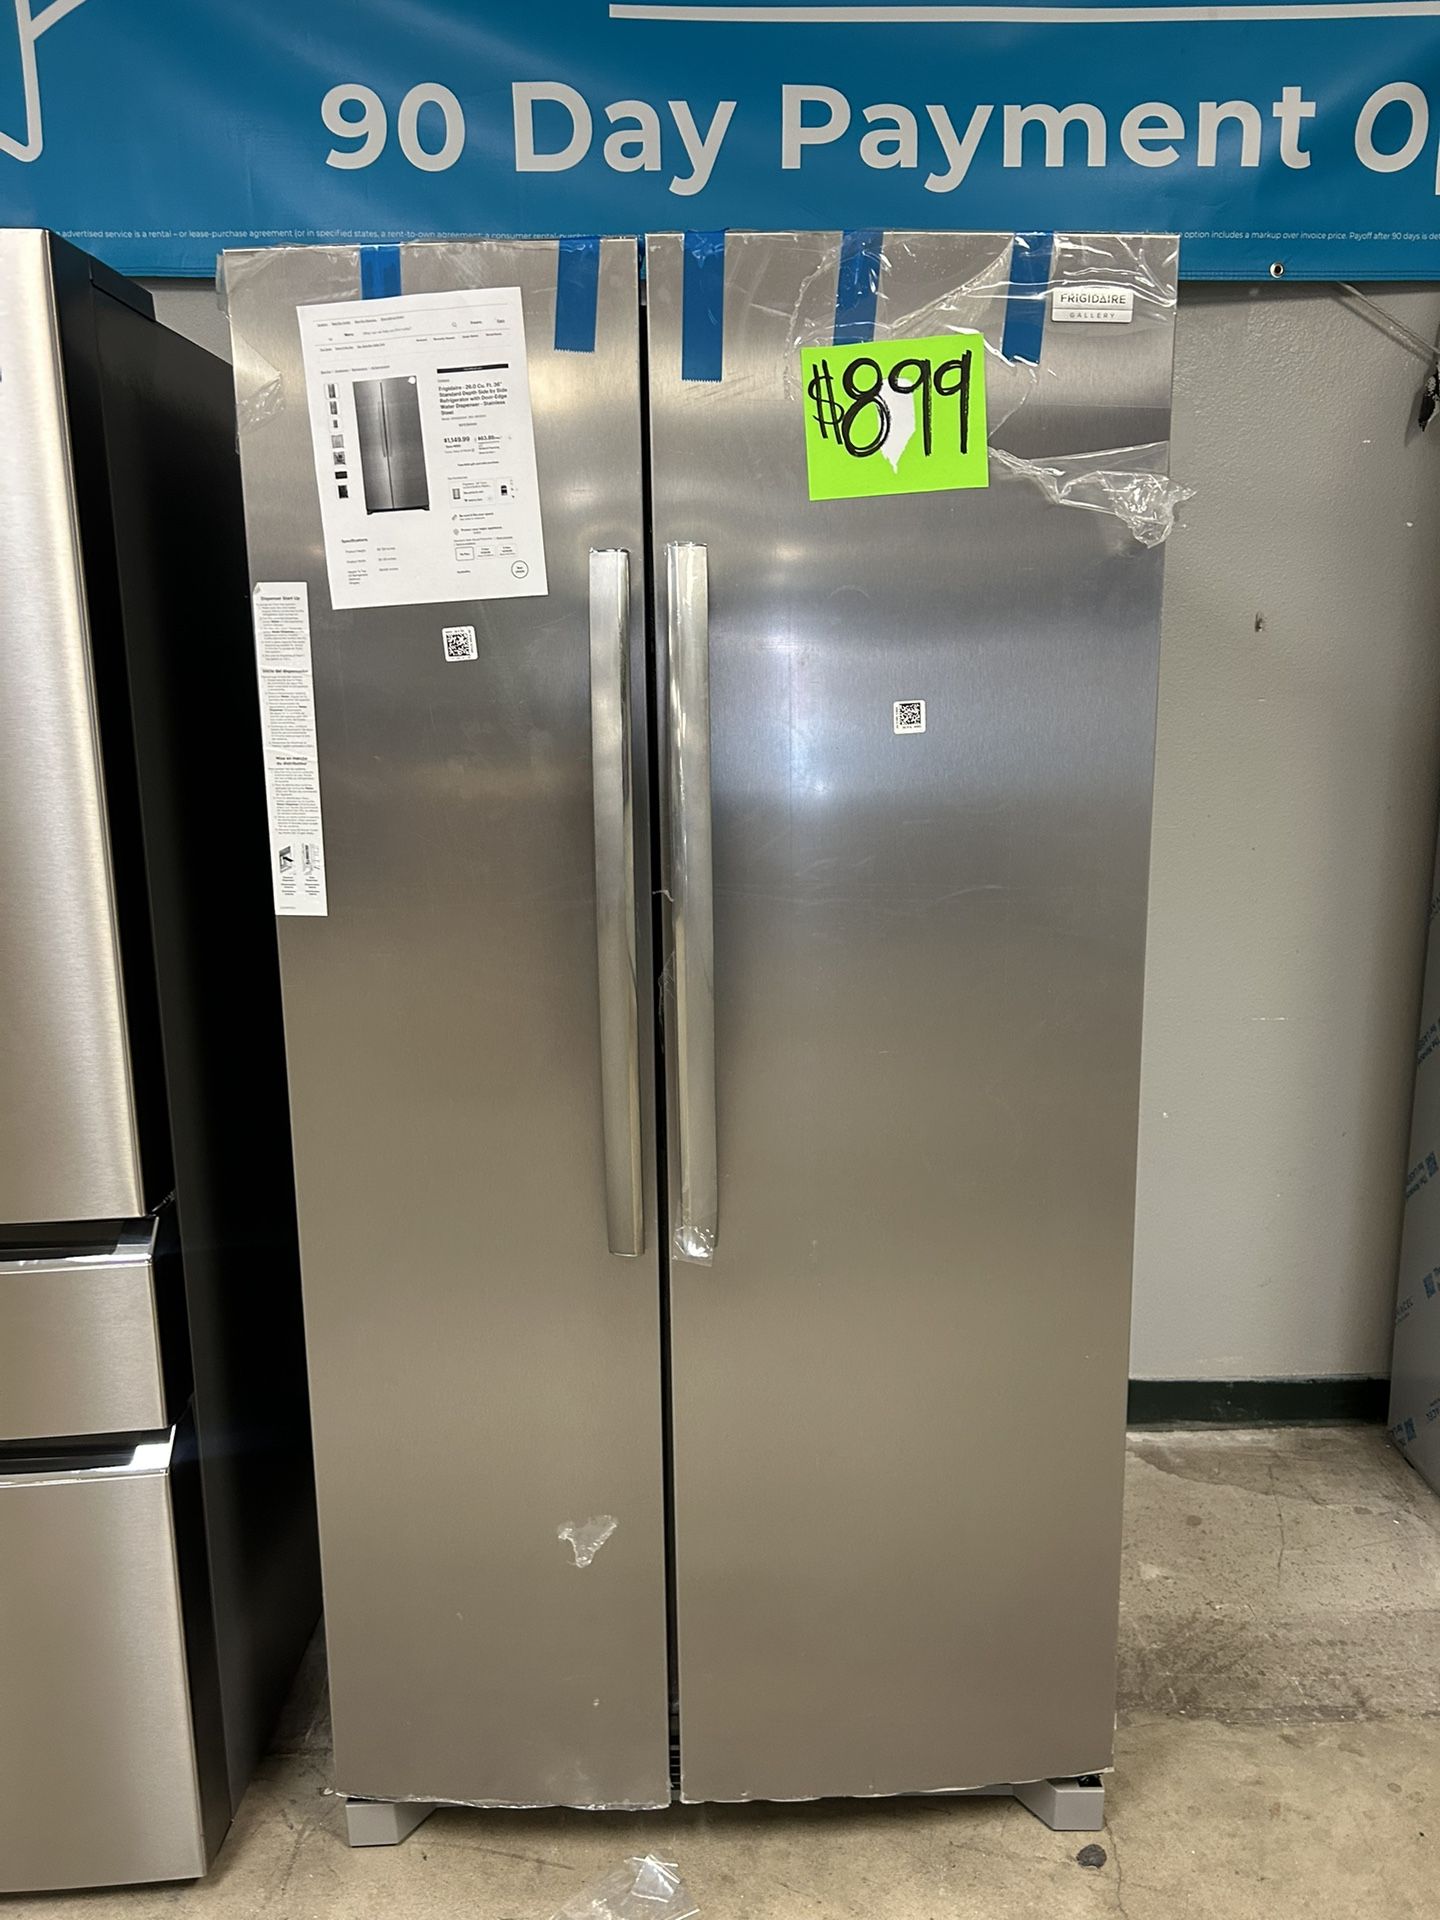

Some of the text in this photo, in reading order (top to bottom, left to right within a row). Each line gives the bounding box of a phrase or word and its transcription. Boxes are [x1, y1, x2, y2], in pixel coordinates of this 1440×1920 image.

[320, 81, 1440, 196] 90 Day Payment O
[63, 231, 103, 239] advertised
[105, 231, 133, 239] service
[134, 231, 140, 239] is
[149, 231, 171, 239] rental
[189, 231, 247, 240] lease-purchase
[249, 231, 293, 241] agreement
[307, 230, 315, 238] in
[316, 230, 353, 240] specified
[354, 231, 380, 239] states,
[387, 231, 436, 239] rent-to-own
[1184, 231, 1210, 241] option
[1211, 231, 1244, 240] includes
[1251, 231, 1281, 241] markup
[1301, 231, 1327, 240] invoice
[1349, 231, 1373, 241] Payoff
[1373, 232, 1390, 240] after
[1392, 232, 1402, 240] 90
[1403, 232, 1421, 242] days
[1060, 293, 1127, 305] FRIGIDAIRE
[807, 349, 972, 458] $899
